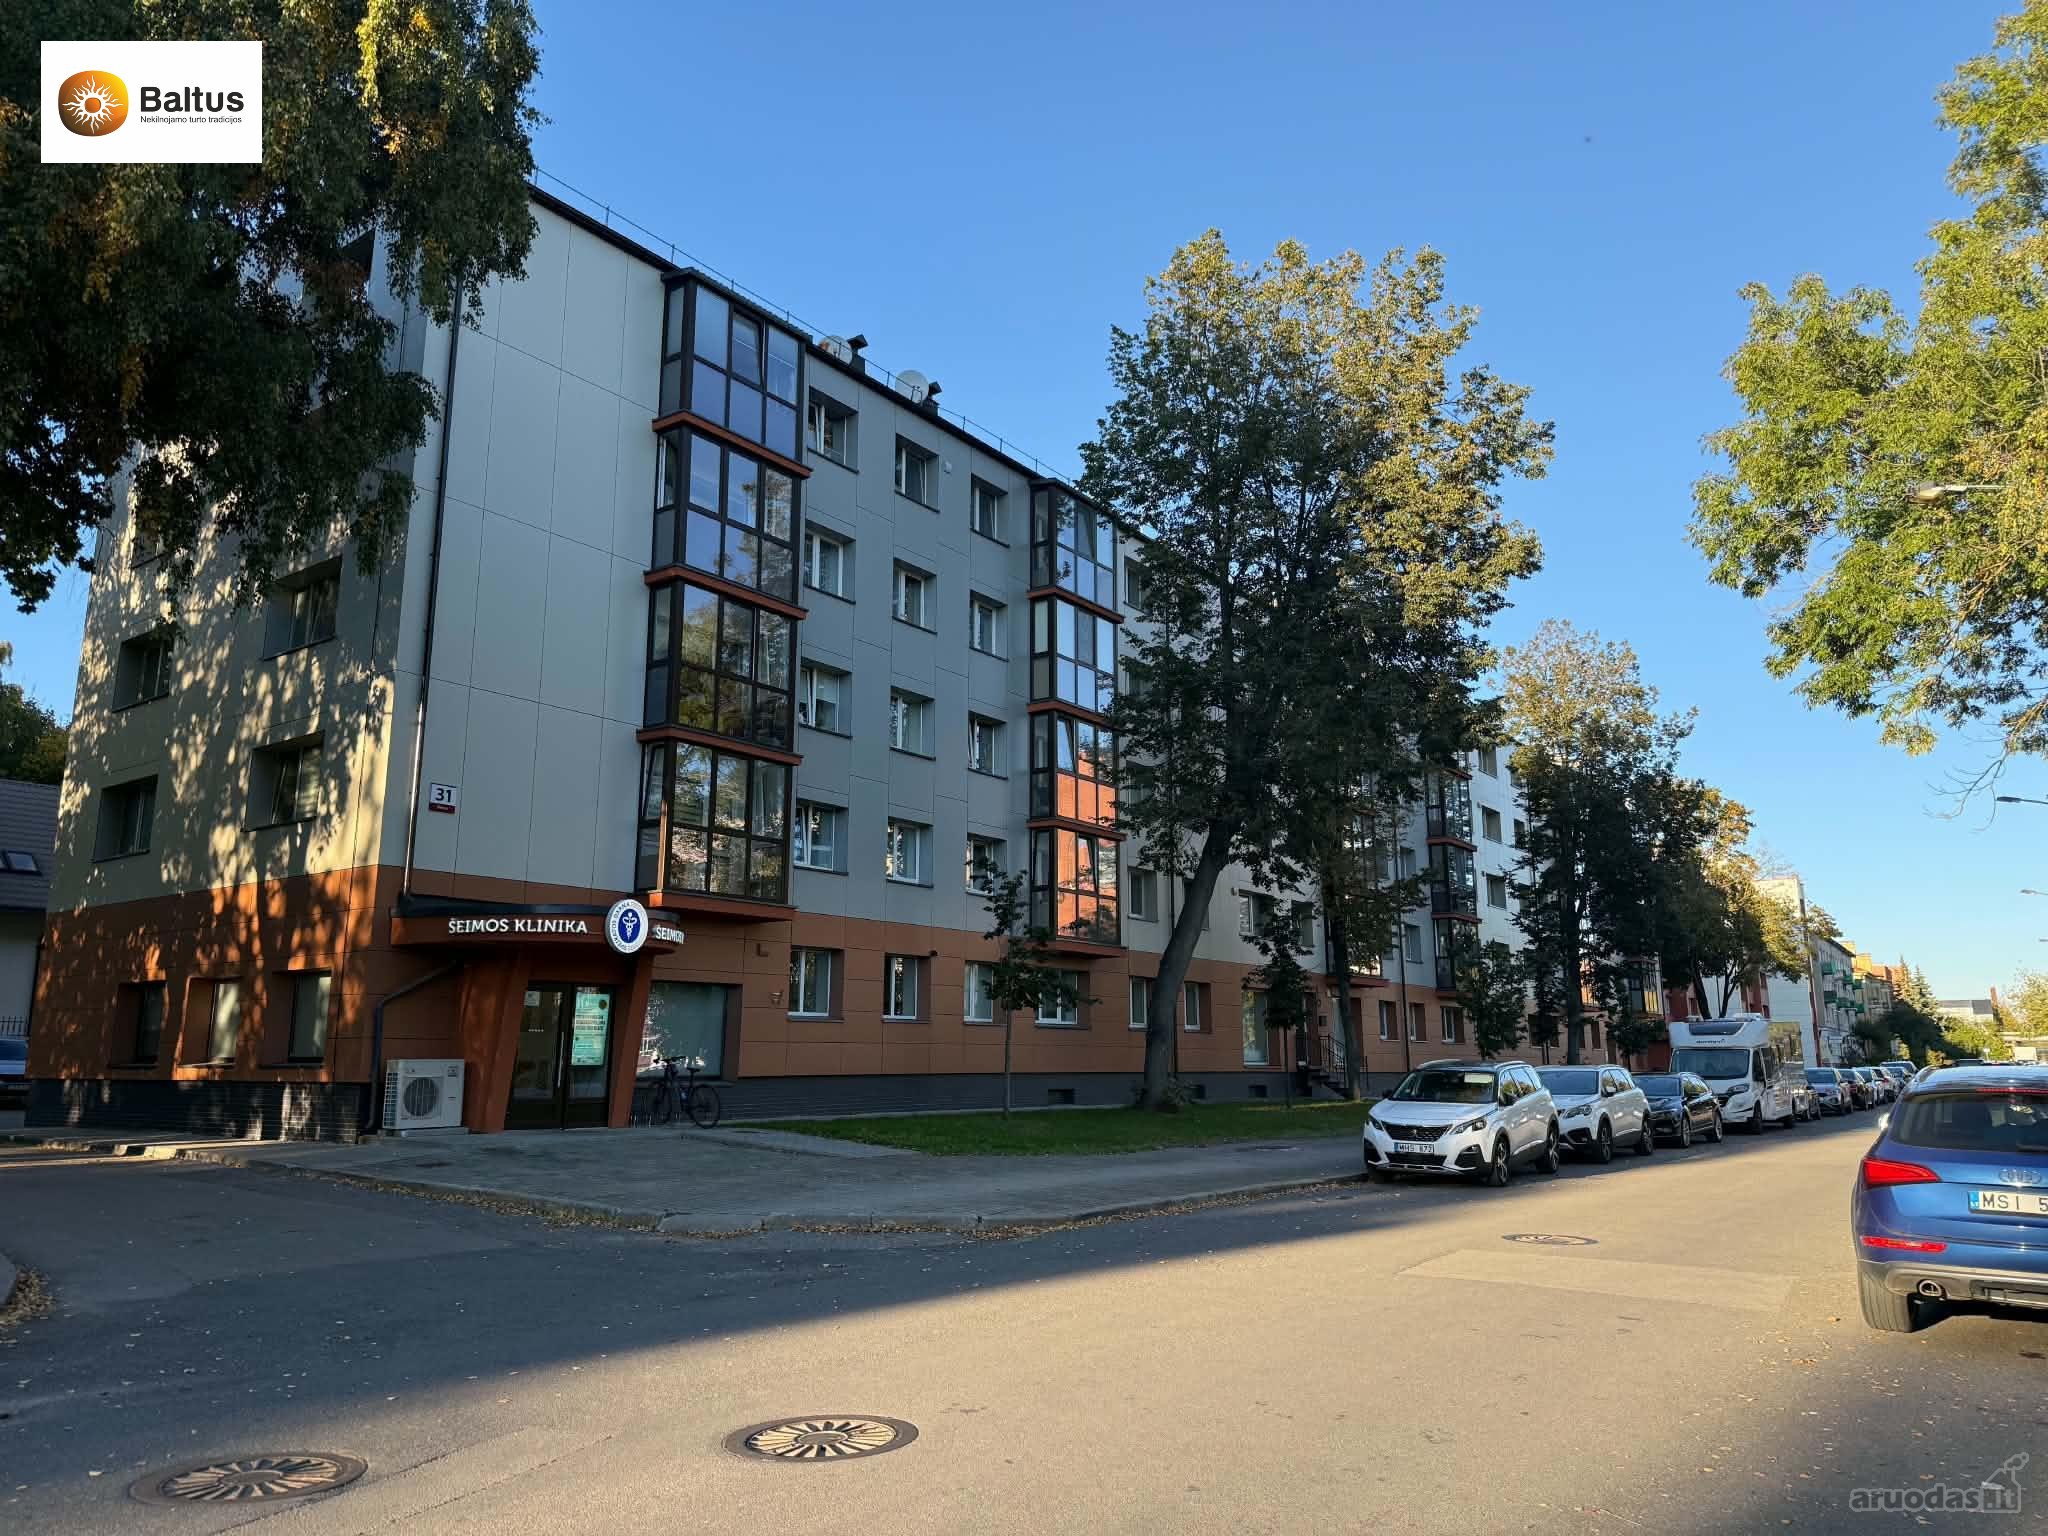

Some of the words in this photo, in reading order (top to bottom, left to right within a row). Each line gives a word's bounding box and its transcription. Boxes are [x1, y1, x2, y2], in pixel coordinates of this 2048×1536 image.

[435, 787, 452, 803] 31
[448, 917, 509, 934] ŠEIMOS
[514, 918, 589, 934] KLINIKA
[1982, 1192, 2020, 1211] MSI
